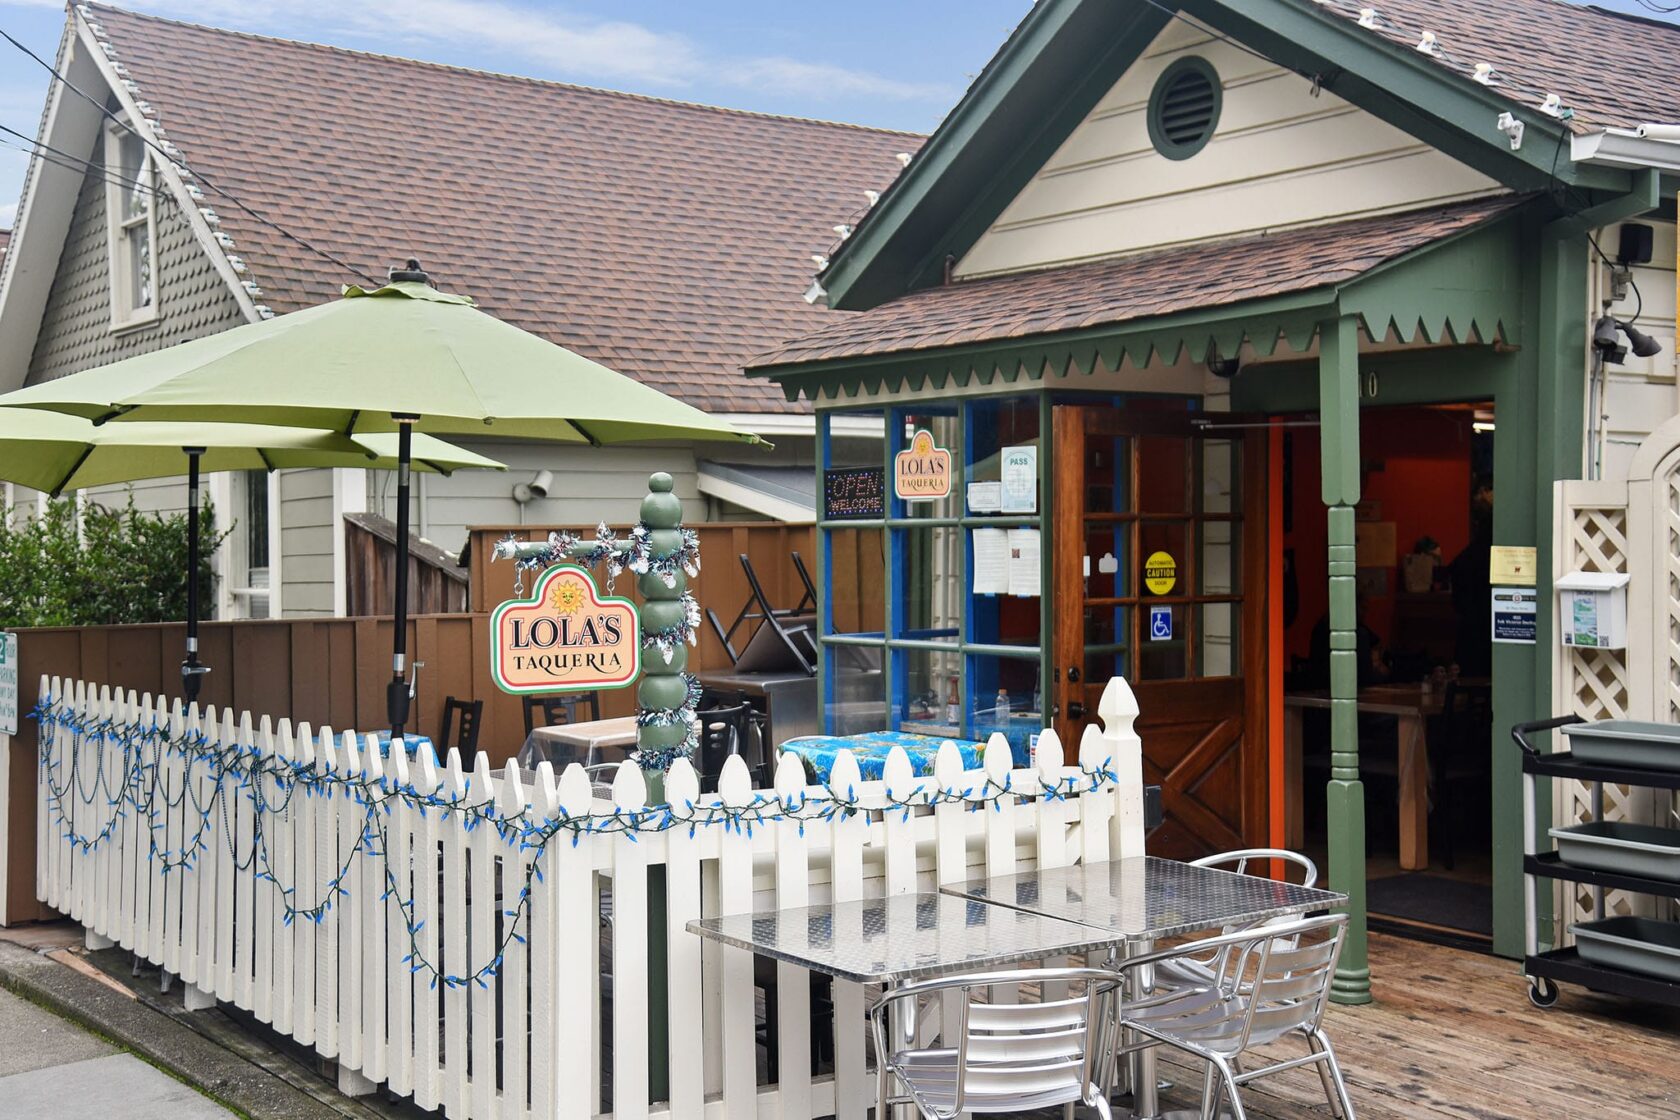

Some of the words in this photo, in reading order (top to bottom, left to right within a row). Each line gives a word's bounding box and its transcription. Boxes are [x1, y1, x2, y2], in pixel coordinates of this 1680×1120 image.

[901, 457, 944, 476] LOLA'S
[1010, 457, 1028, 466] PASS
[833, 474, 878, 497] OPEN
[902, 479, 944, 491] TAQUERIA
[830, 498, 881, 512] WELCOME
[1147, 568, 1175, 578] CAUTION
[510, 614, 621, 650] LOLA'S
[513, 652, 621, 676] TAQUERIA
